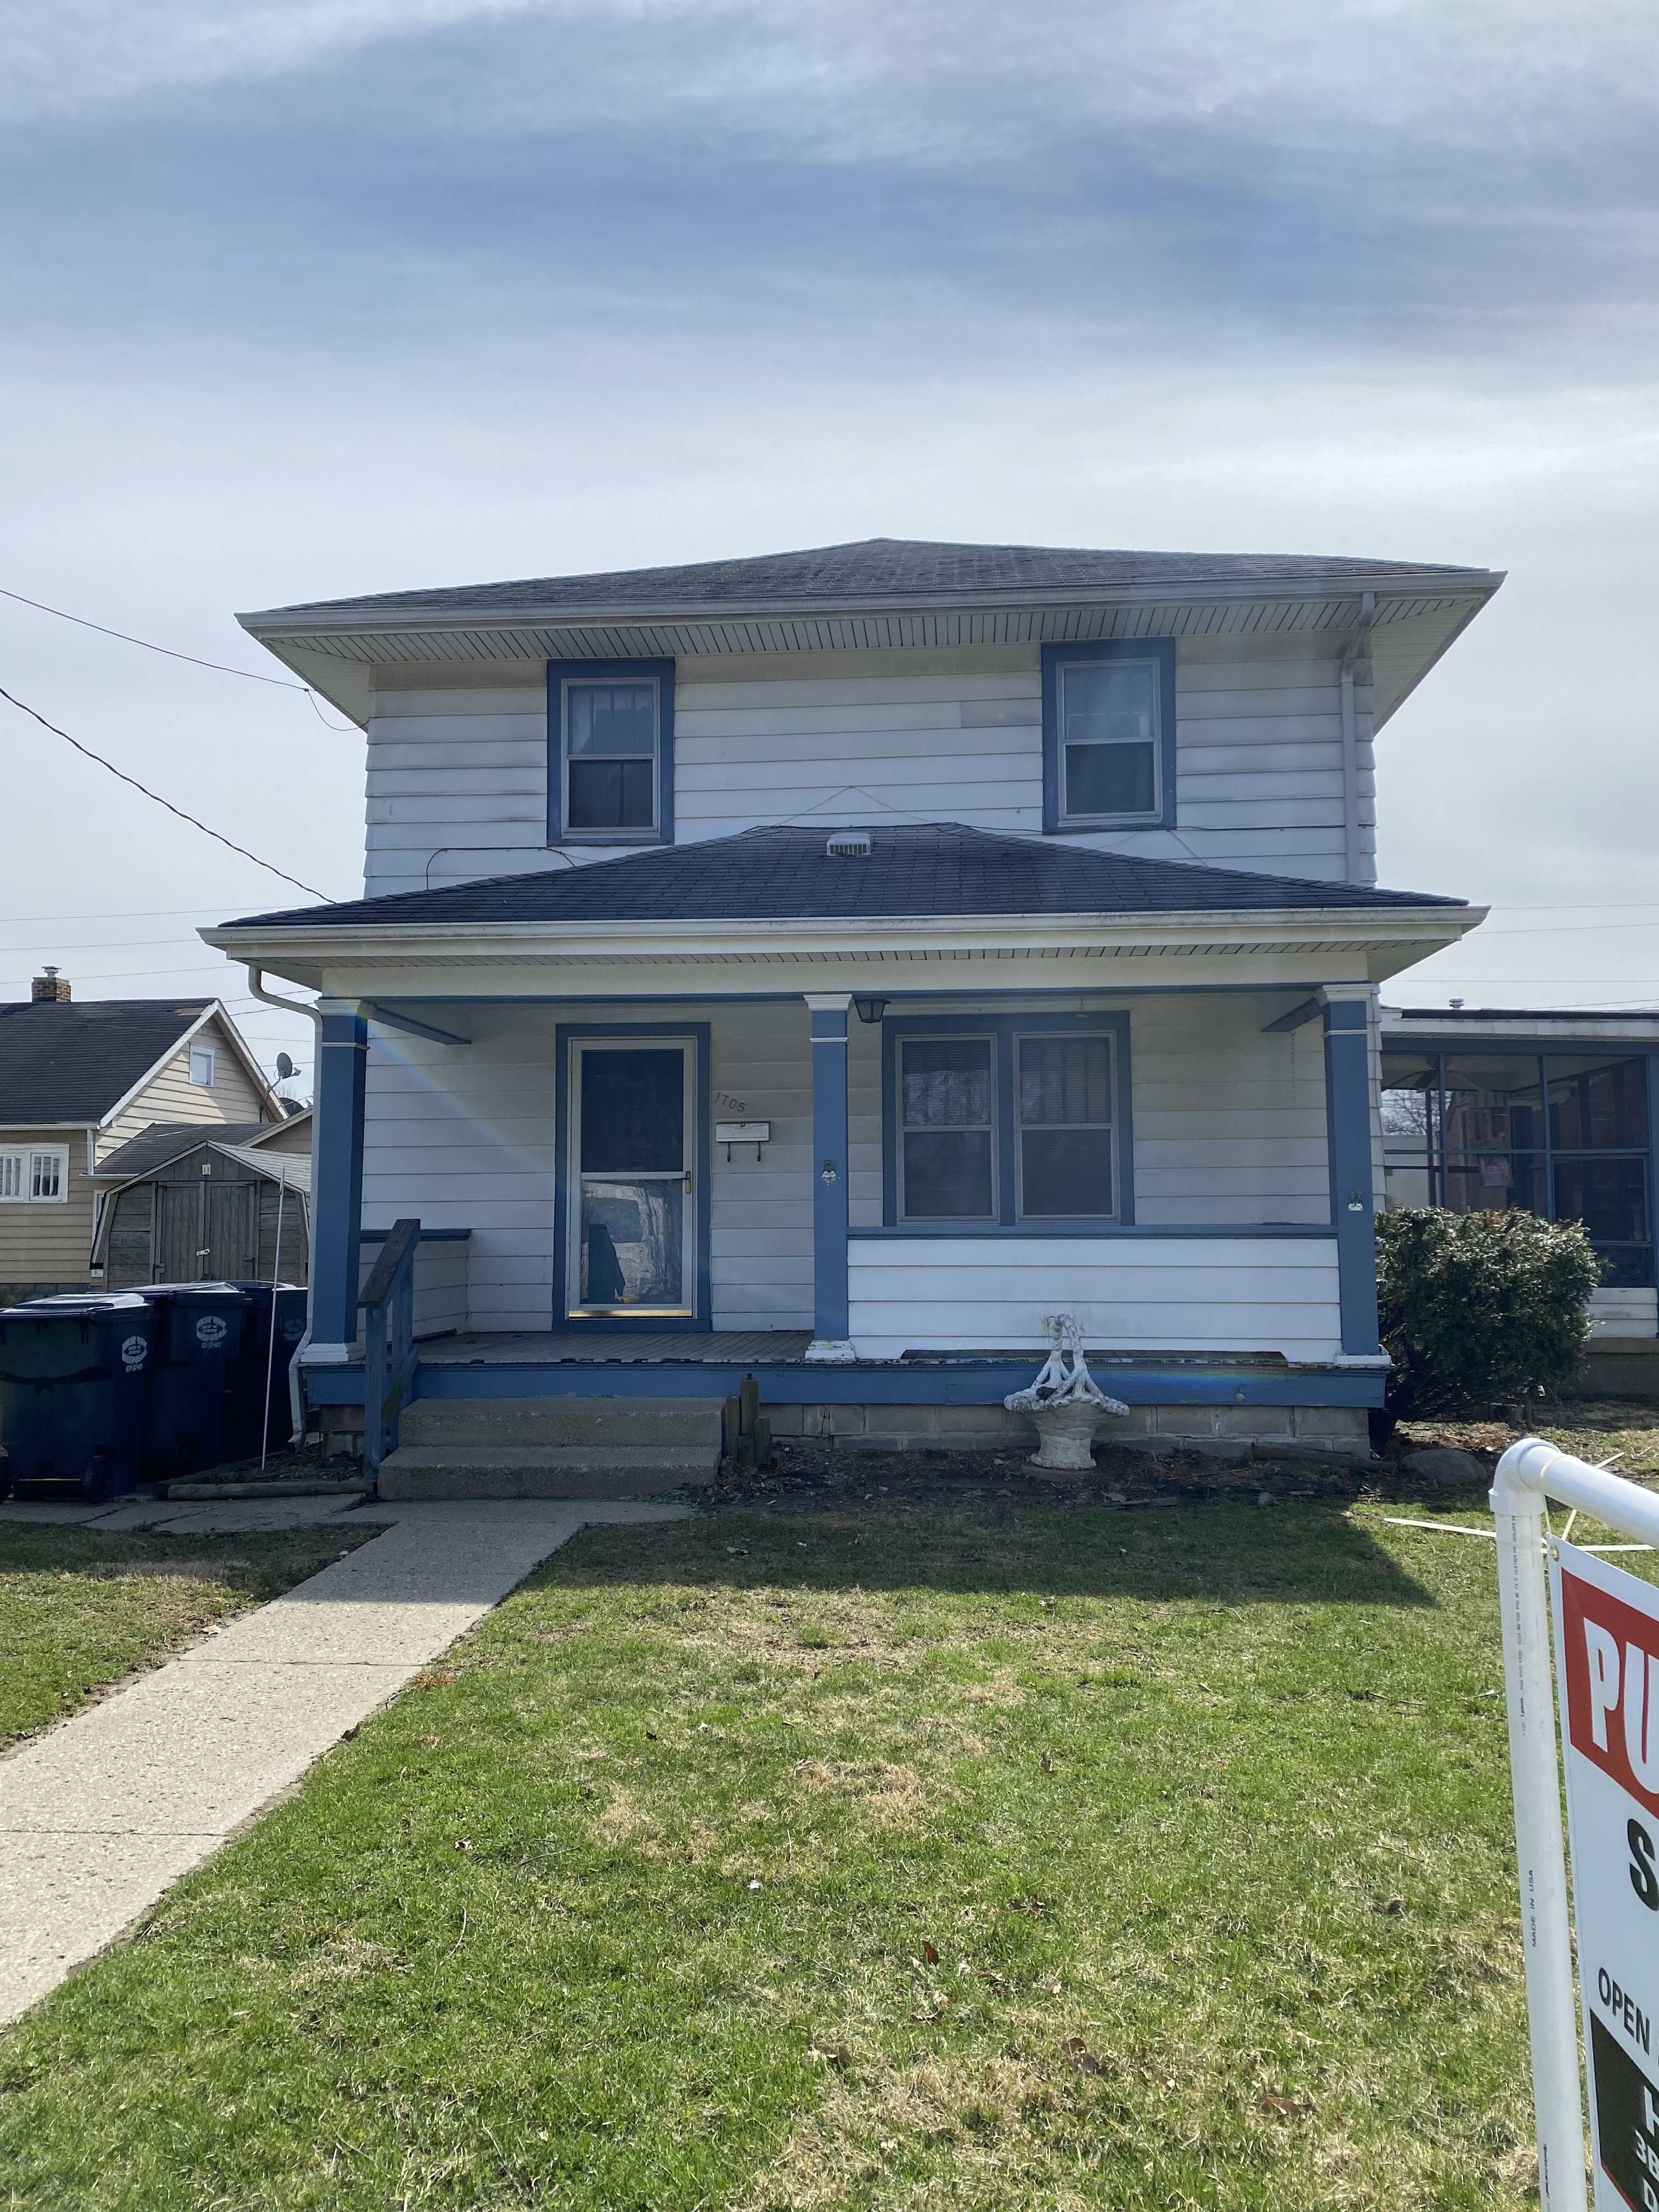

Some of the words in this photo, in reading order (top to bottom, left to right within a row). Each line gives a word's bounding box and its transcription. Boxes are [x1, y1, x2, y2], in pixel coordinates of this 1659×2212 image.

[714, 1091, 747, 1113] 1705
[1583, 1617, 1659, 1794] PU
[1530, 1898, 1535, 1910] IN
[1598, 1967, 1650, 2056] OPEN
